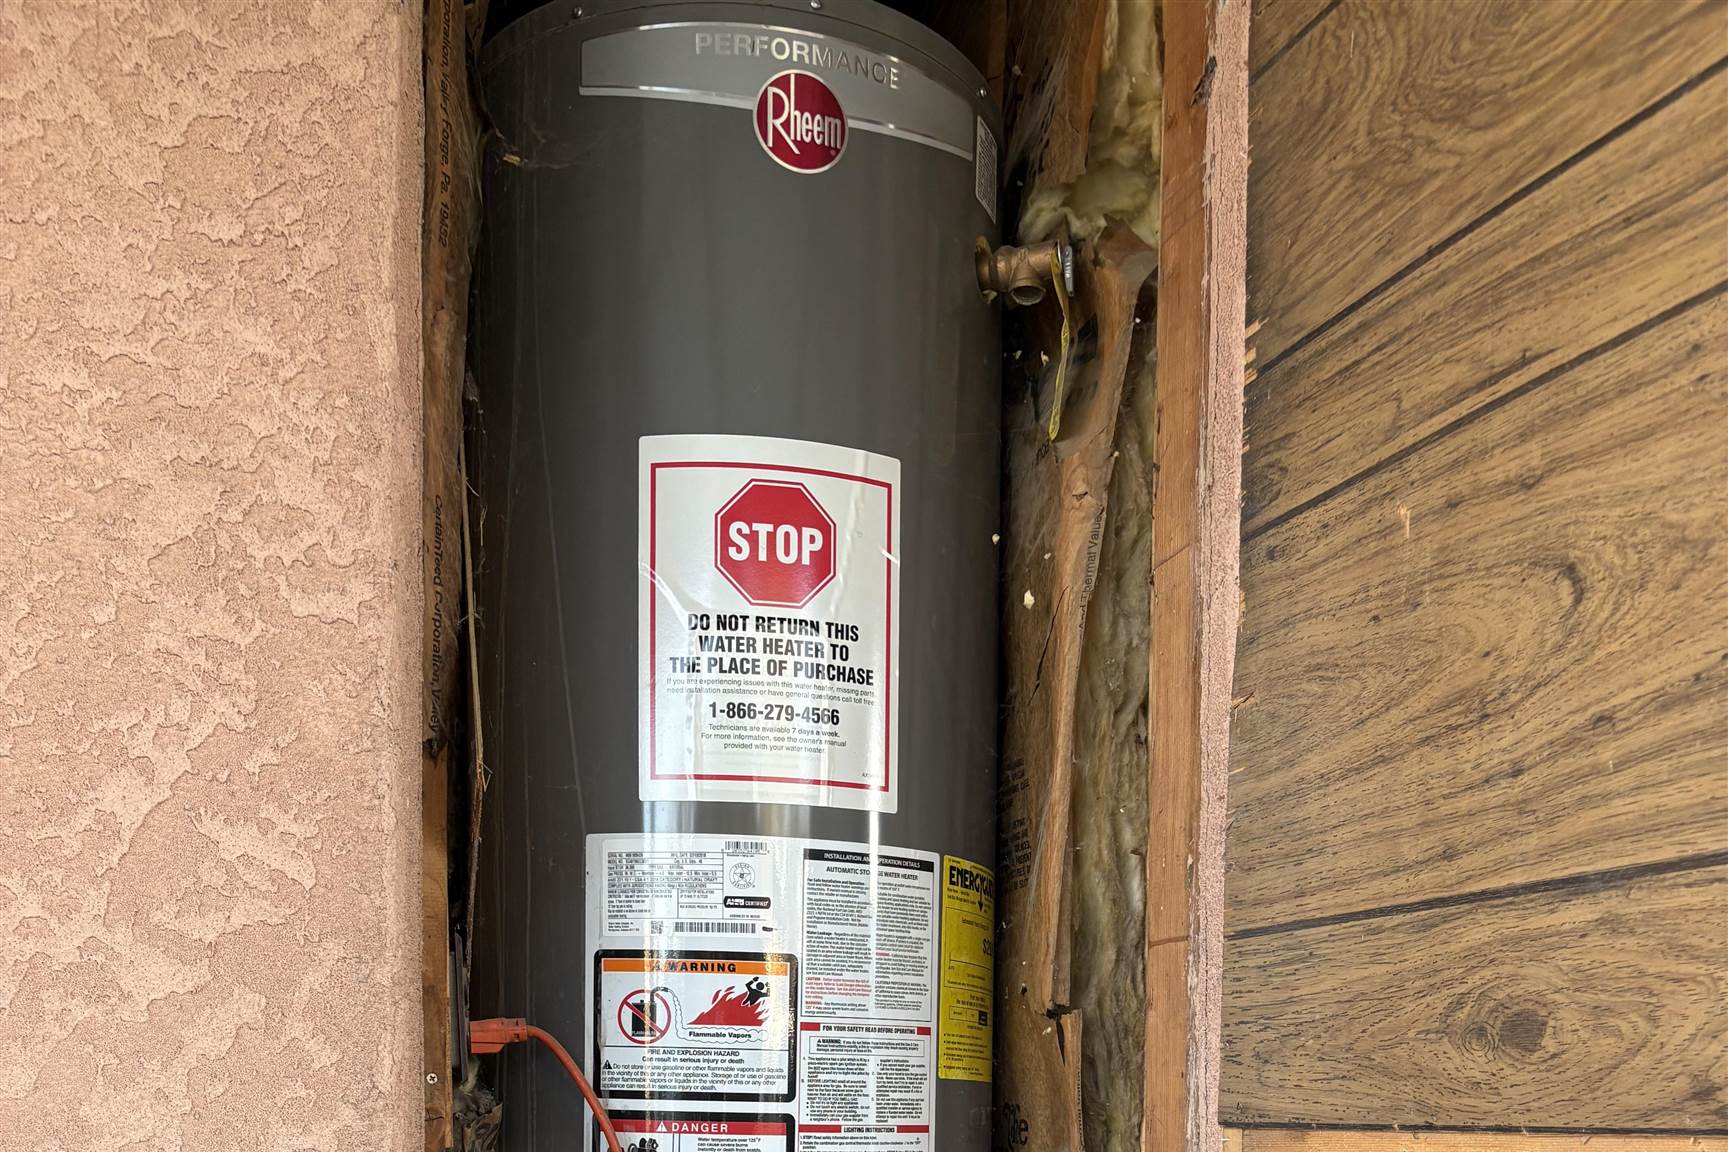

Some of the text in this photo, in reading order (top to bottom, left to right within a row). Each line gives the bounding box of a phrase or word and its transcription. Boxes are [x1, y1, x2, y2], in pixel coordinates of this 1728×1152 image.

[695, 32, 899, 90] PERFORMANCE
[766, 73, 842, 154] Rheem
[727, 520, 823, 566] STOP
[1080, 552, 1097, 602] Thermal
[688, 613, 859, 642] DO NOT RETURN THIS
[699, 635, 849, 661] WATER HEATER TO
[670, 656, 874, 686] THE PLACE OF PURCHASE
[699, 679, 742, 688] experiencing
[836, 686, 859, 695] missing
[722, 687, 758, 695] assistance
[785, 690, 809, 700] general
[811, 692, 840, 702] questions
[842, 695, 852, 703] call
[708, 701, 840, 725] 1-866-279-4566
[708, 723, 749, 732] Technicians
[798, 728, 814, 737] days
[821, 730, 840, 738] week.
[723, 742, 753, 751] provided
[754, 743, 768, 751] with
[732, 733, 772, 742] information,
[798, 736, 822, 745] owner's
[824, 738, 847, 747] manual
[824, 852, 862, 862] INSTALLATION
[877, 858, 902, 866] PERATION
[902, 860, 921, 869] DETAILS
[826, 866, 919, 881] AUTOMATIC STOGE WATER HEATER
[669, 962, 737, 973] WARNING
[688, 1031, 752, 1040] Flammable Vapors
[676, 1049, 712, 1057] EXPLOSION
[679, 1056, 701, 1064] serious
[702, 1057, 719, 1065] injury
[616, 1069, 633, 1077] vicinity
[683, 1071, 709, 1079] appliance.
[709, 1072, 733, 1080] Storage
[662, 1064, 684, 1072] gasoline
[621, 1075, 647, 1083] flammable
[674, 1077, 692, 1085] liquids
[709, 1078, 726, 1086] vicinity
[671, 1122, 729, 1133] DANGER
